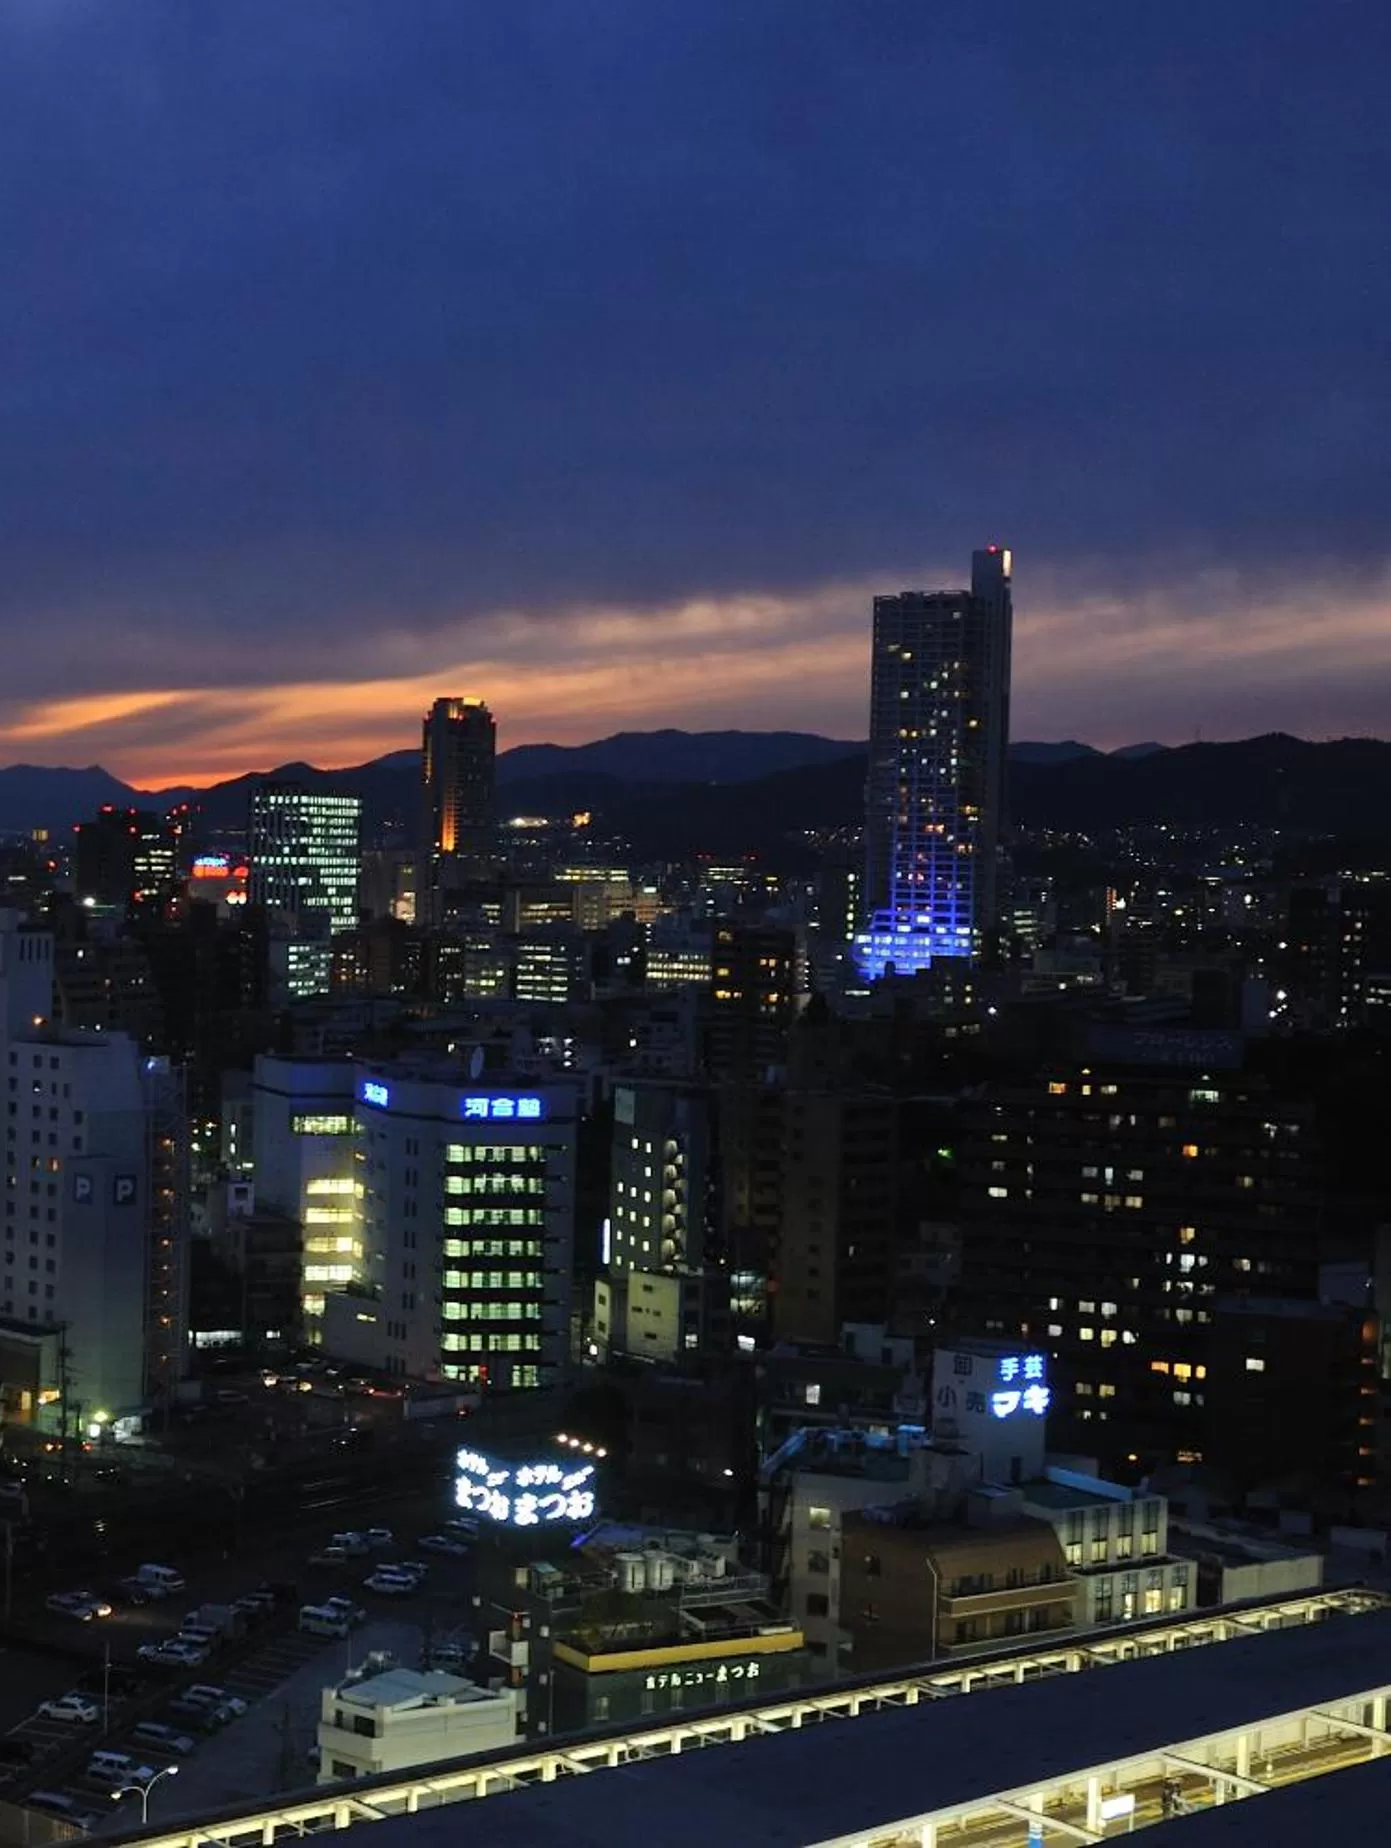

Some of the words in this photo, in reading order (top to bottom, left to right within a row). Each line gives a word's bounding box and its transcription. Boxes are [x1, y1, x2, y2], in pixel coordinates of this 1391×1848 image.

[75, 1175, 91, 1201] P
[116, 1178, 134, 1203] P
[514, 1489, 595, 1526] まつお
